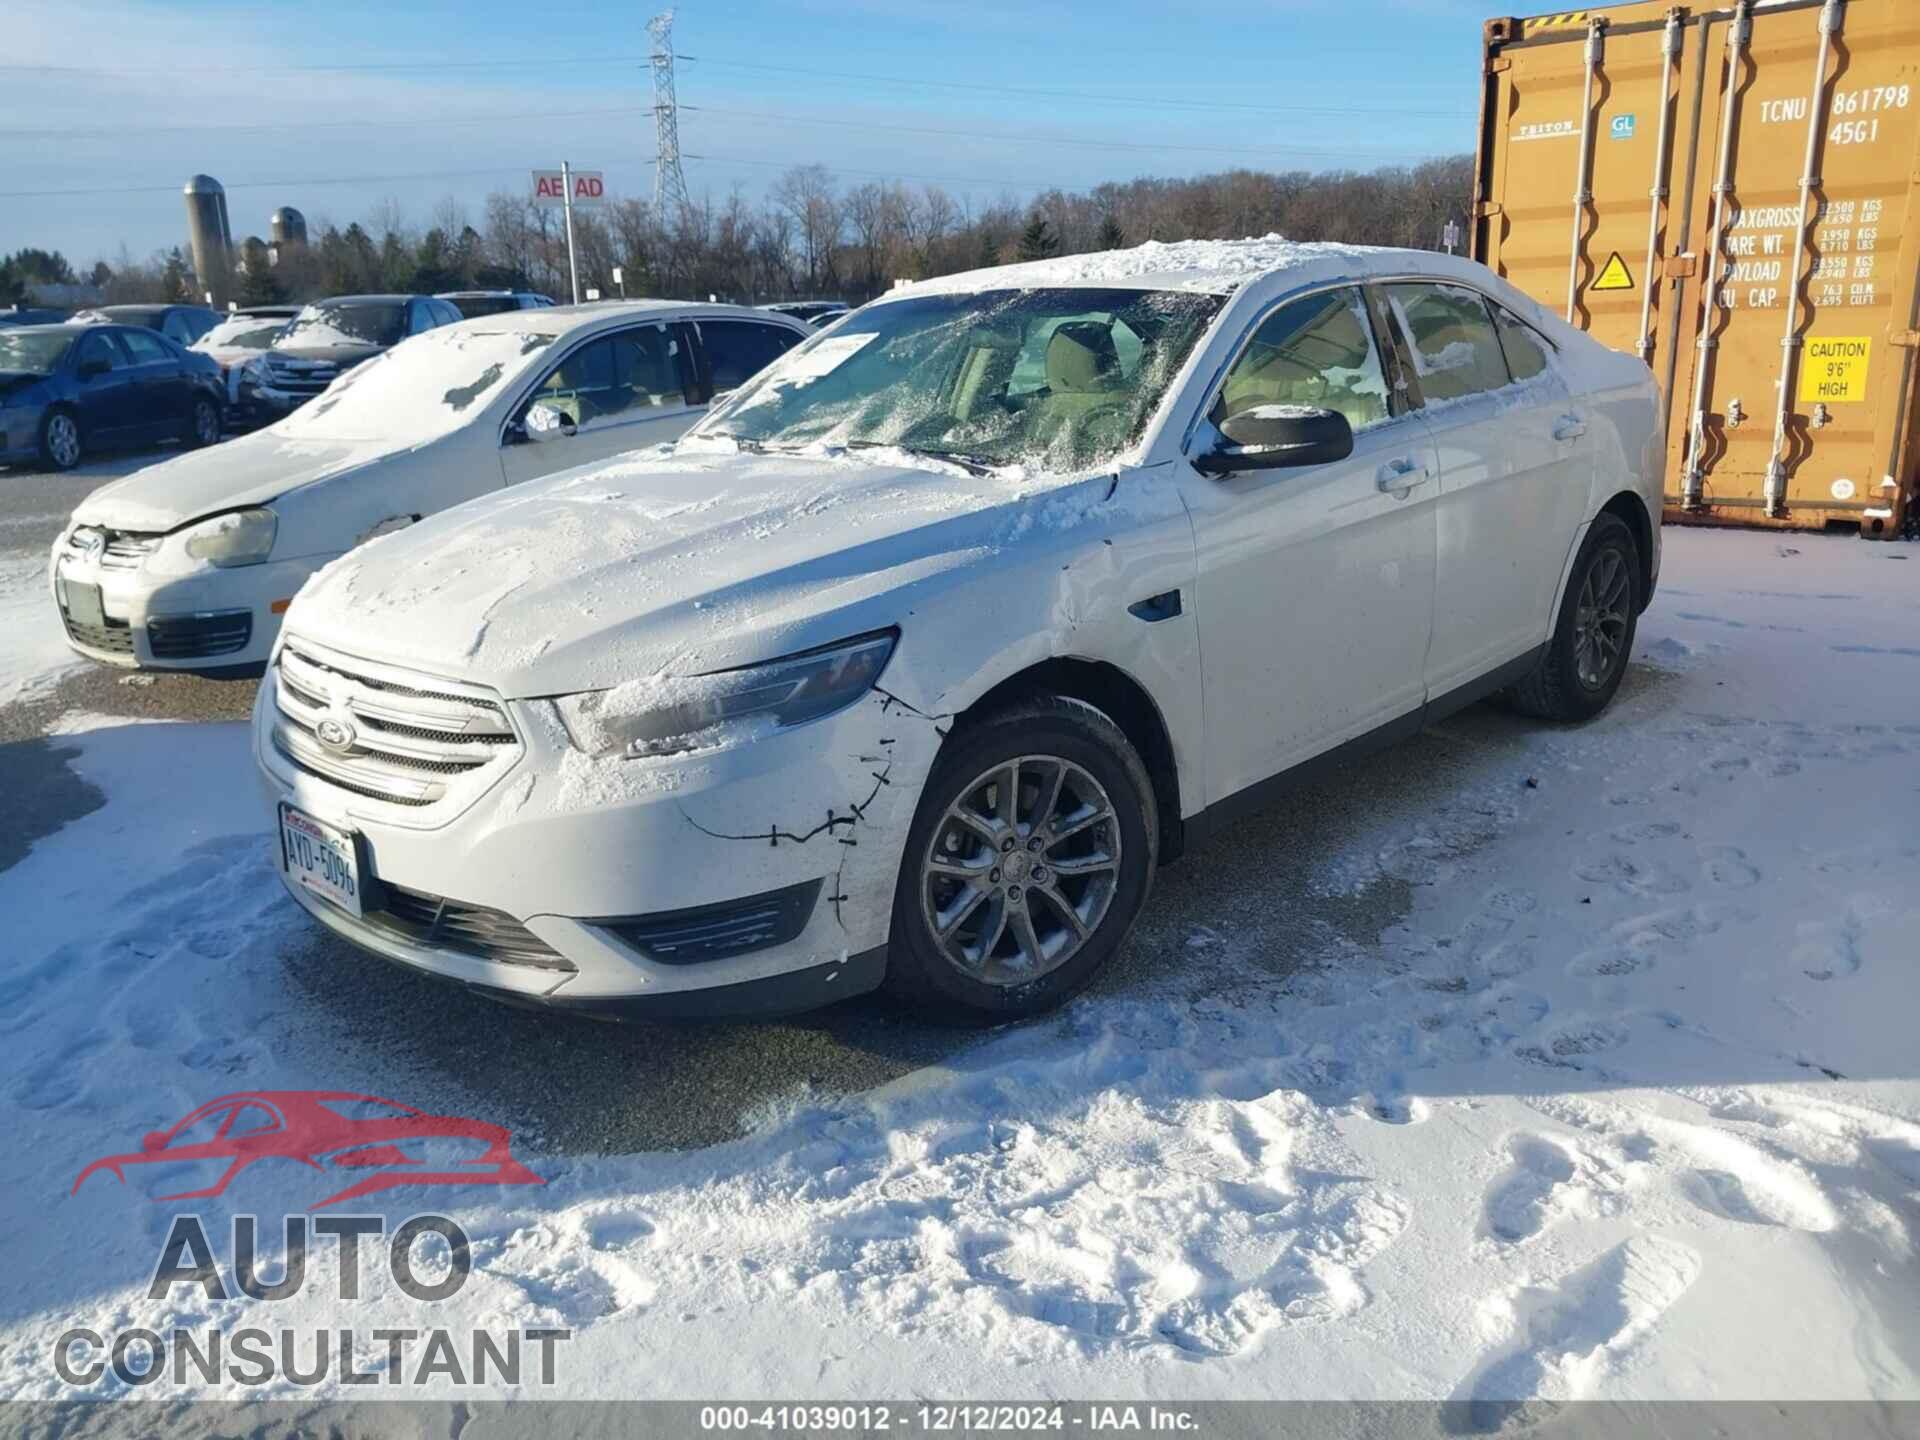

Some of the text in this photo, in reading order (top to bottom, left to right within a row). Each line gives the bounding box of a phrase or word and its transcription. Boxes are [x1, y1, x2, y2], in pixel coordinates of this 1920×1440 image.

[1760, 85, 1909, 123] TCNU 861798
[1611, 116, 1634, 131] GL
[1829, 118, 1879, 144] 45G1
[1727, 207, 1800, 229] MAXGROSS
[1725, 235, 1757, 256] TARE
[1763, 233, 1784, 255] WT.
[1722, 261, 1781, 282] PAYLOAD
[1718, 287, 1739, 309] CU.
[1748, 287, 1780, 308] CAP.
[1810, 342, 1867, 358] CAUTION
[1817, 381, 1849, 397] HIGH
